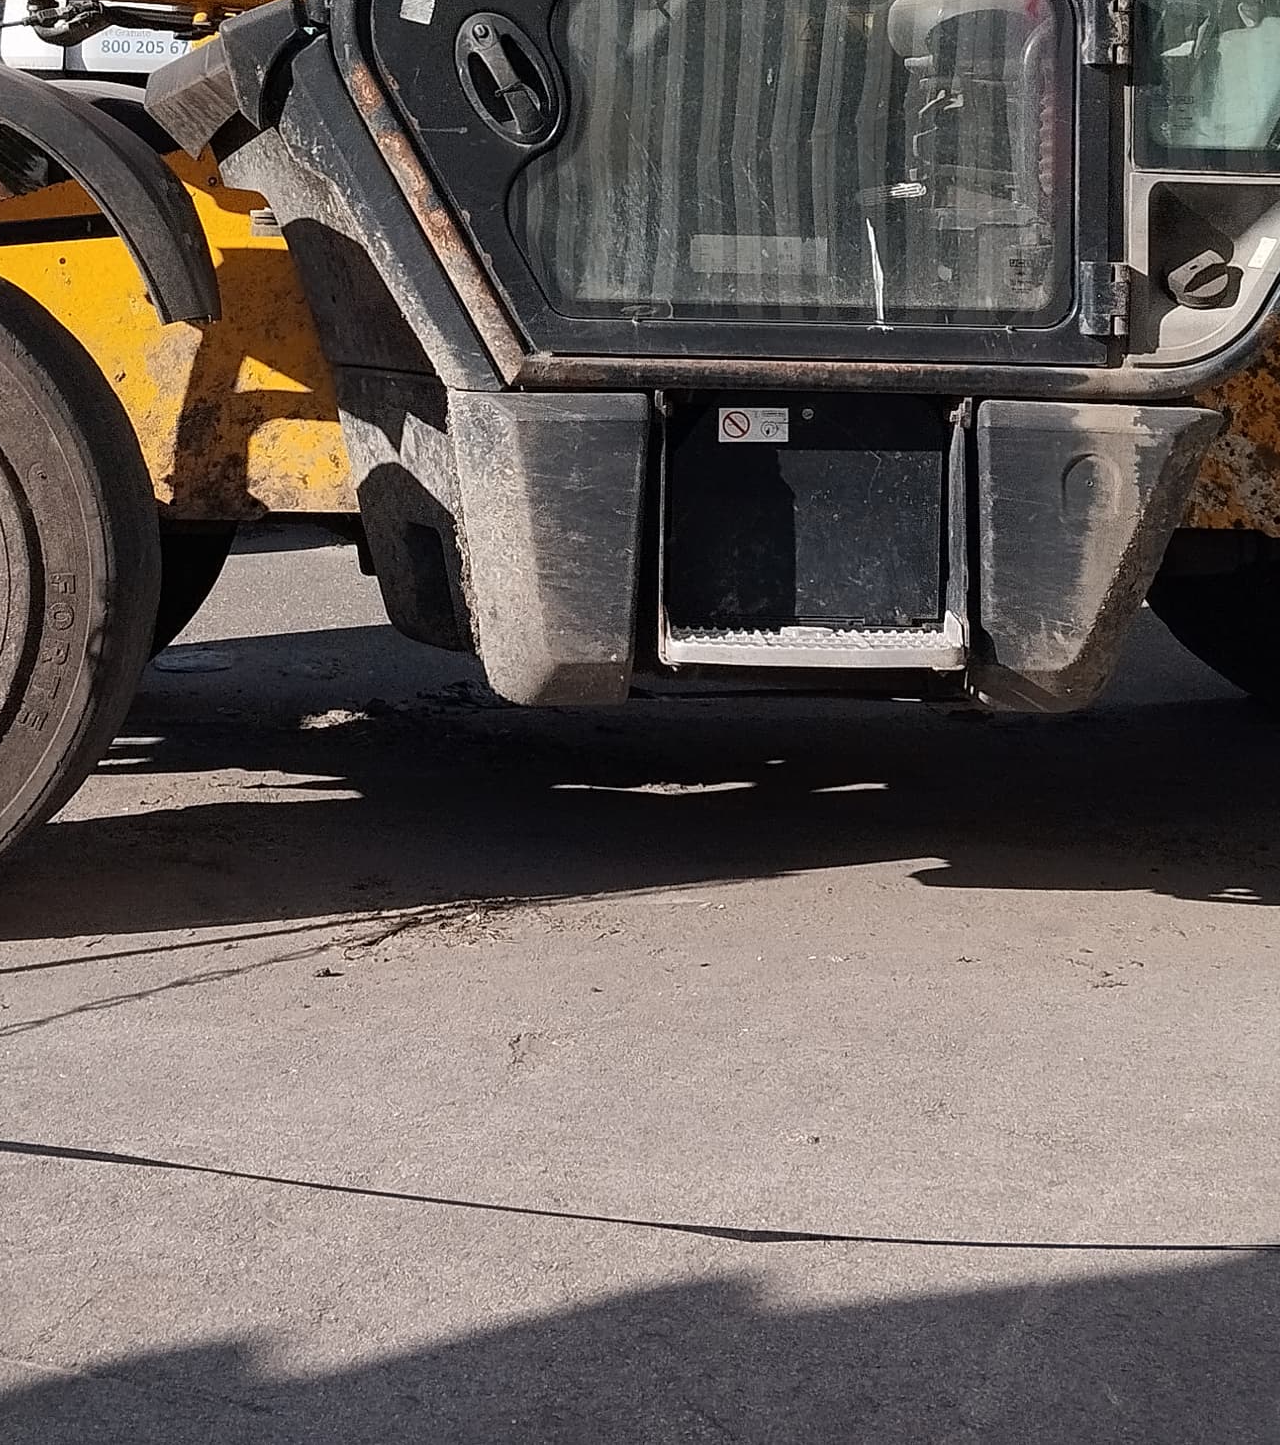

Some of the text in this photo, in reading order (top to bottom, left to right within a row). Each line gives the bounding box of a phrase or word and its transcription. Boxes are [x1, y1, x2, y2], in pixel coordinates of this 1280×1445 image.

[101, 40, 131, 54] 800
[136, 40, 164, 54] 205
[16, 572, 77, 734] FORTE
